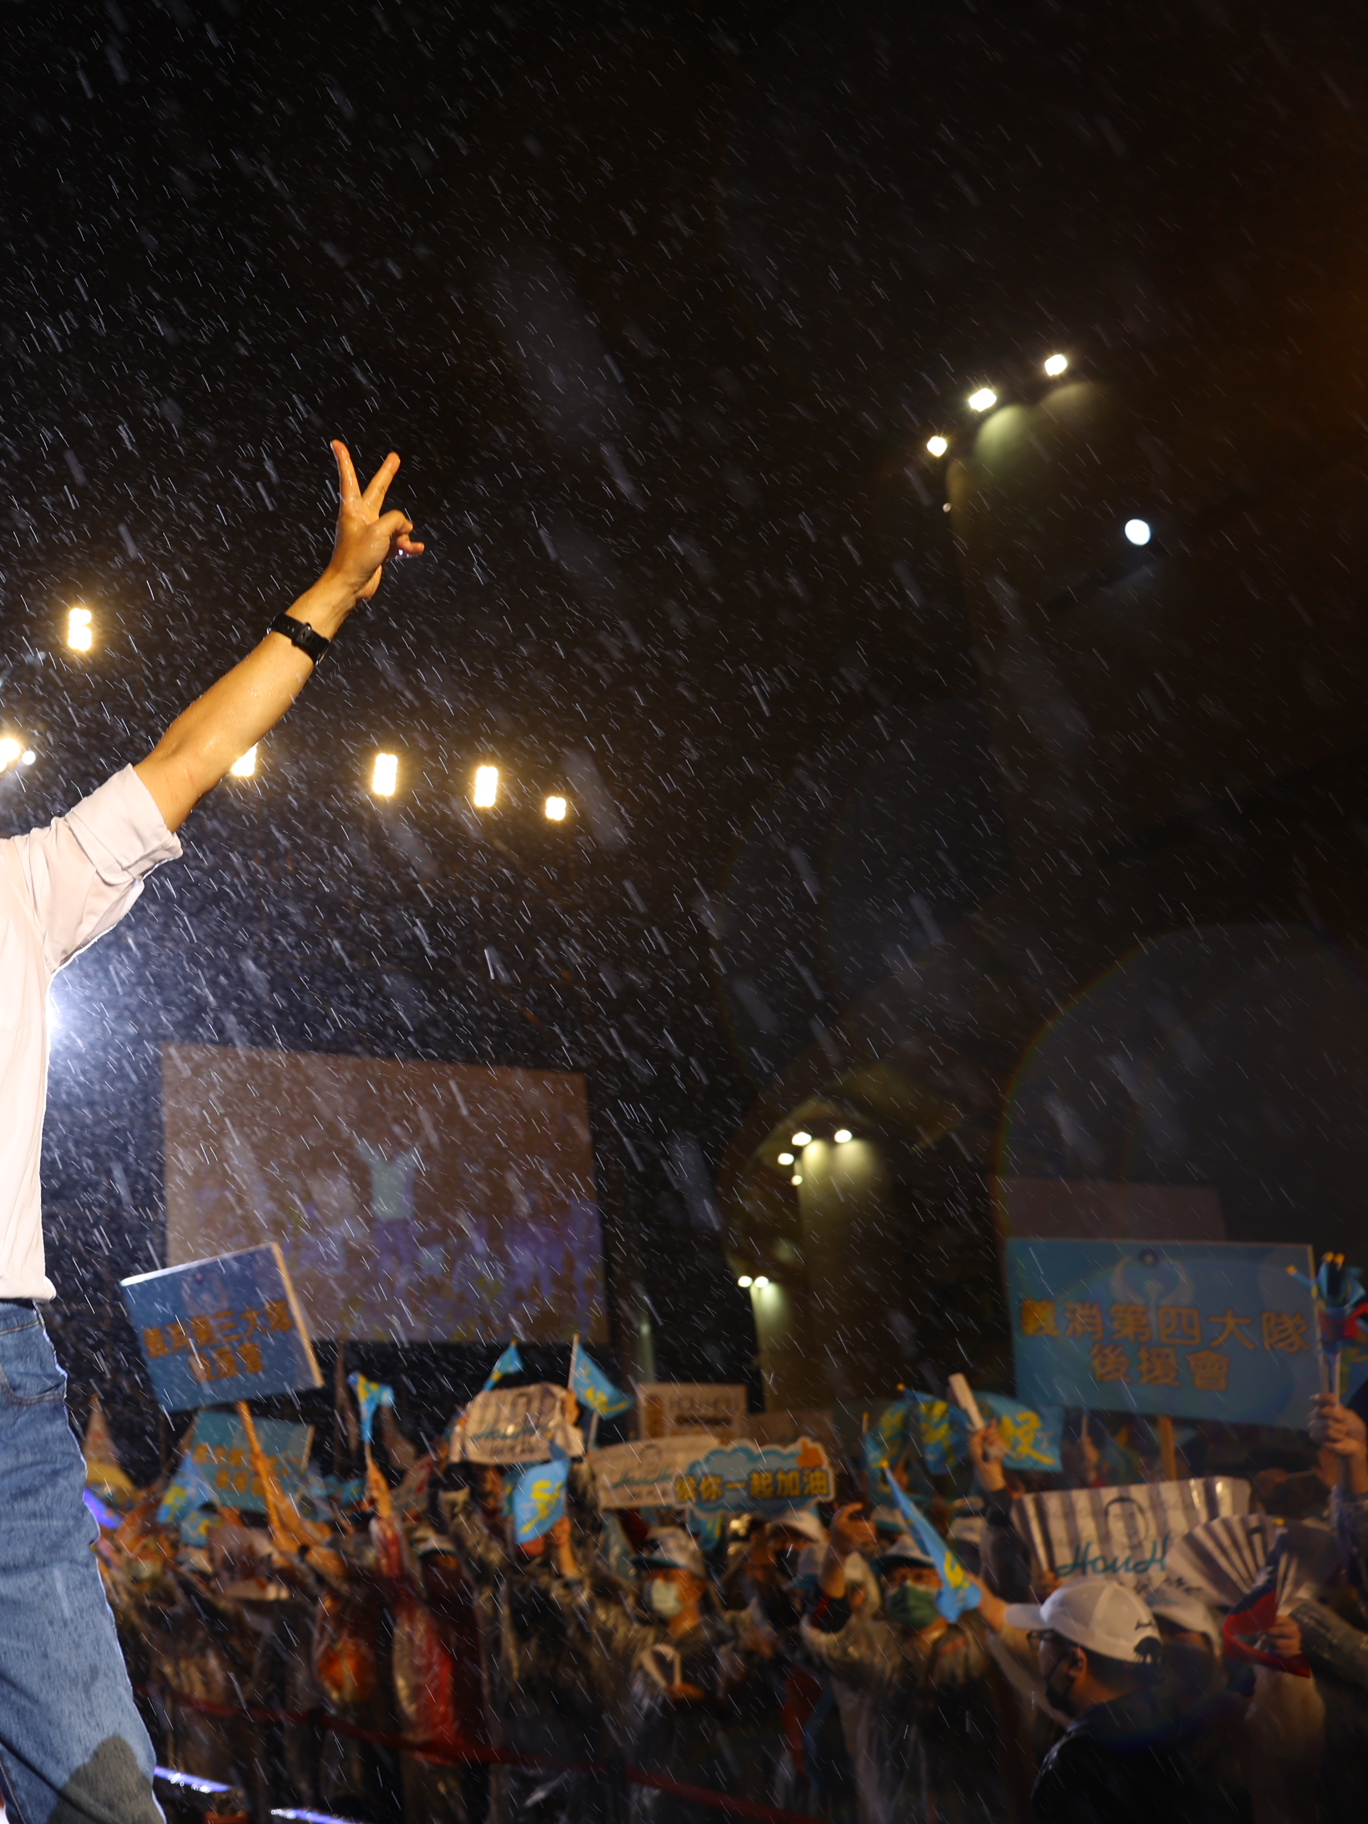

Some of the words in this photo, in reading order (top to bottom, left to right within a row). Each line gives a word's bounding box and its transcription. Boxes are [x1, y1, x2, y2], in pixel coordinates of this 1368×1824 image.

[1020, 1298, 1312, 1354] 義消第四大隊
[1090, 1344, 1231, 1391] 後援會
